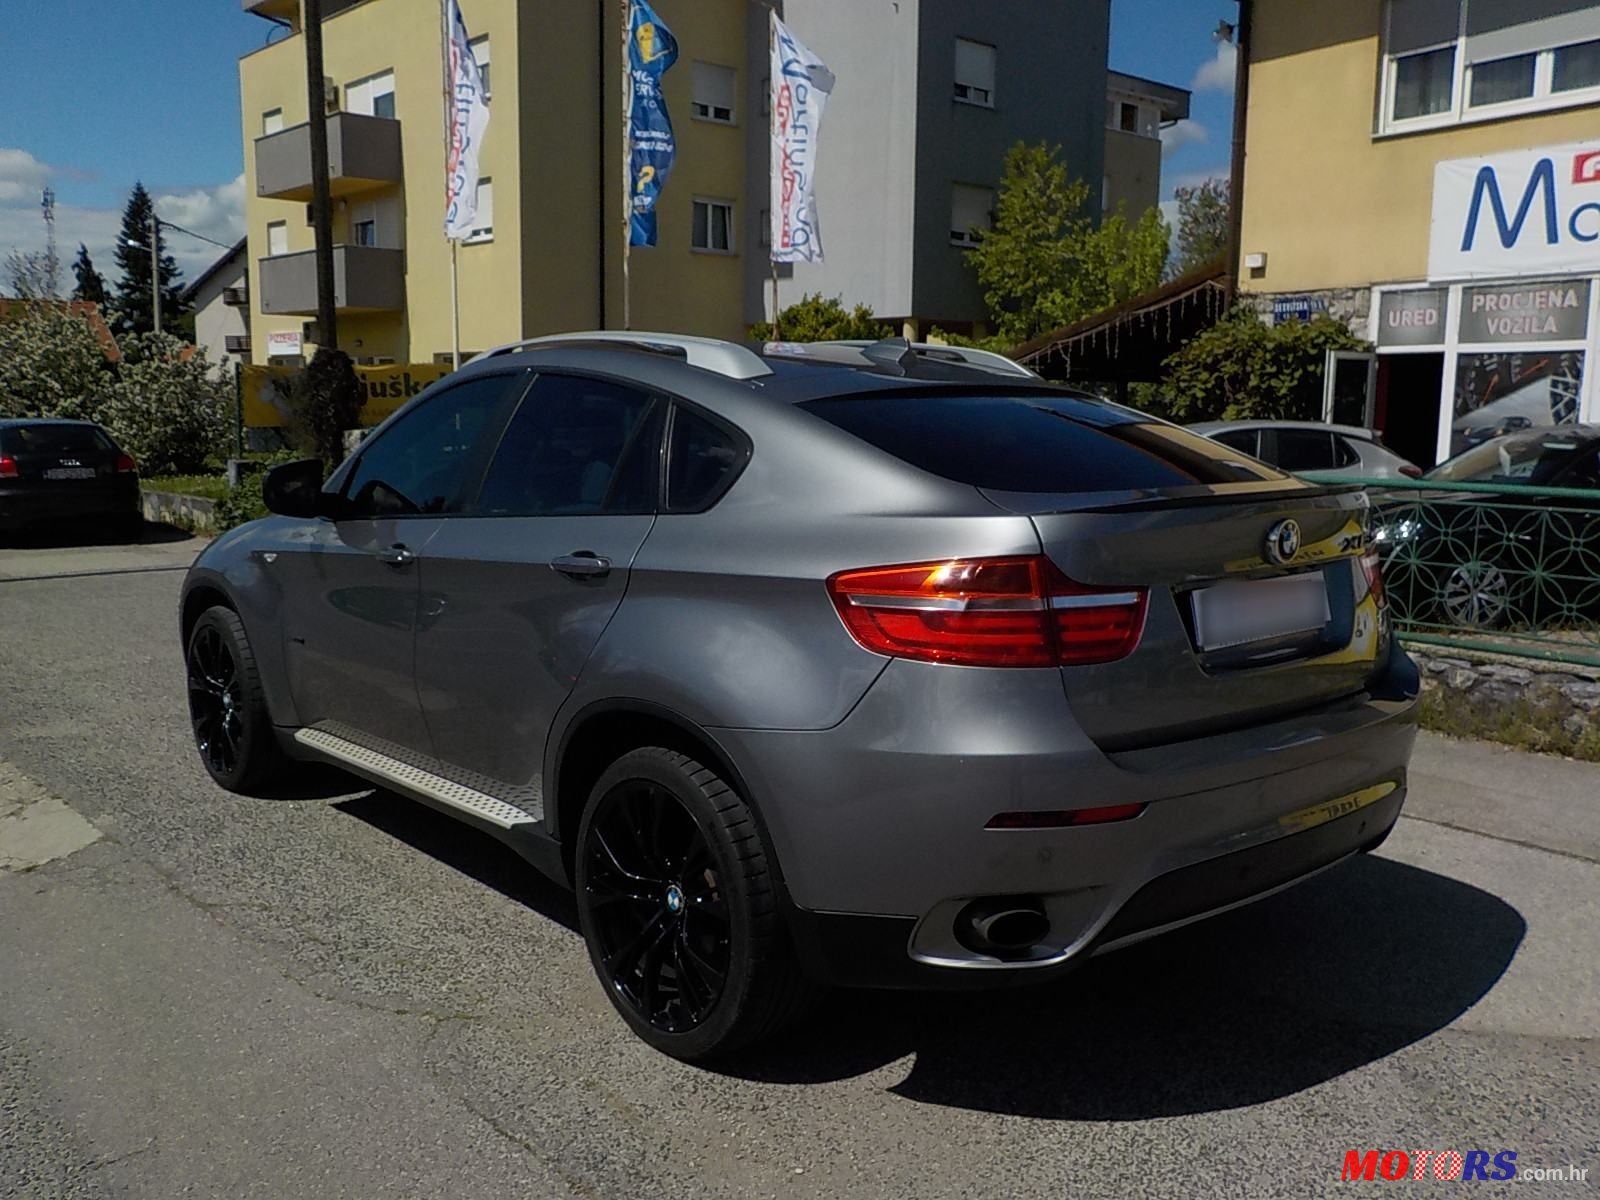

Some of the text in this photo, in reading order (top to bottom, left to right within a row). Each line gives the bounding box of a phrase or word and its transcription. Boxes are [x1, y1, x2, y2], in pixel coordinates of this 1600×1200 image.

[1471, 289, 1579, 313] PROCJENA
[1388, 308, 1438, 328] URED
[1486, 316, 1558, 336] VOZILA
